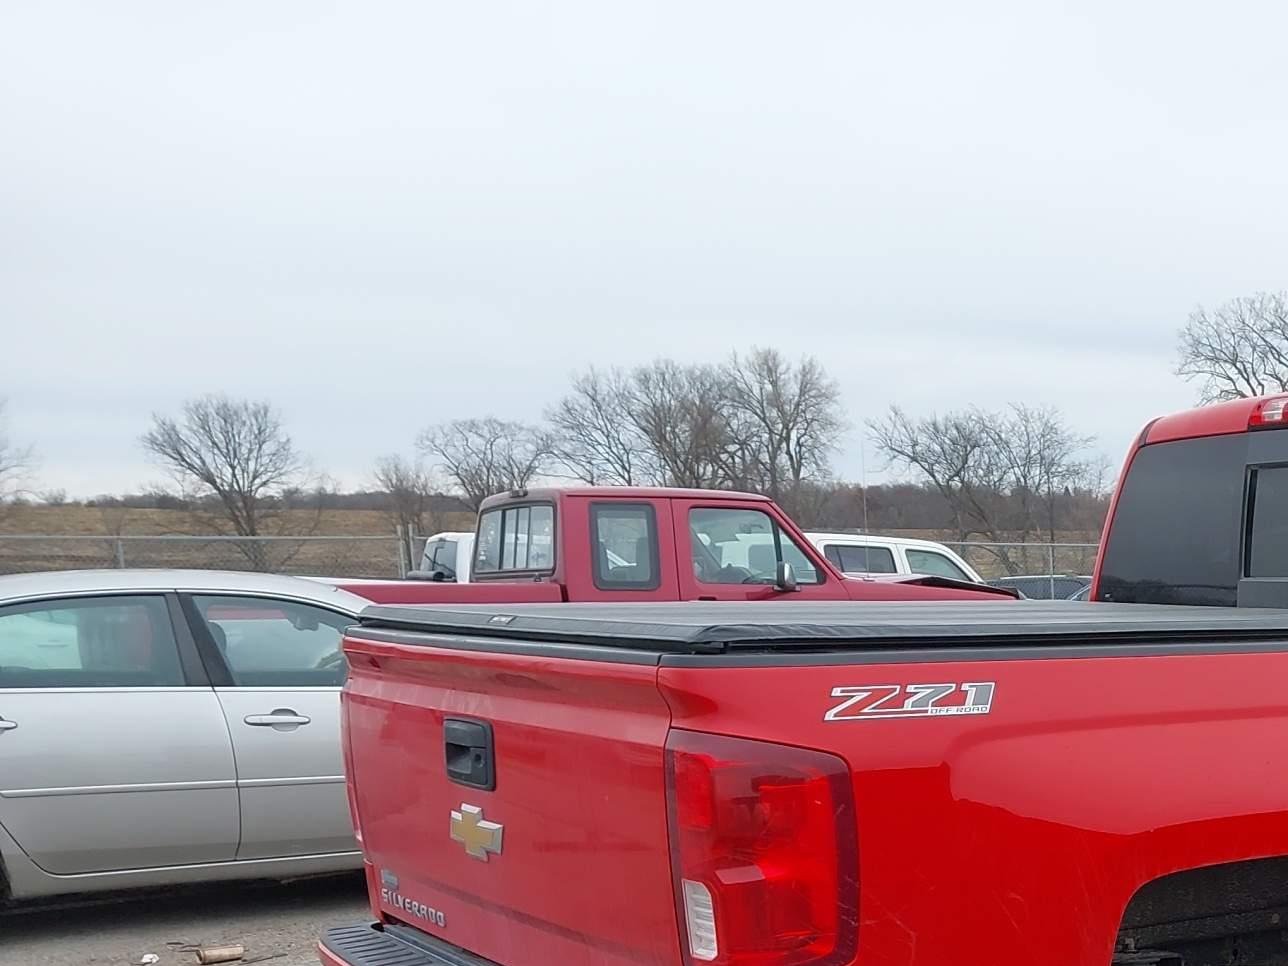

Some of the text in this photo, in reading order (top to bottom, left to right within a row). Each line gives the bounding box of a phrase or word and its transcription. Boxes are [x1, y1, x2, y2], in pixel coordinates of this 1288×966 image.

[824, 681, 996, 721] Z71
[930, 704, 988, 715] OFF ROAD
[381, 888, 446, 928] SILVERADO
